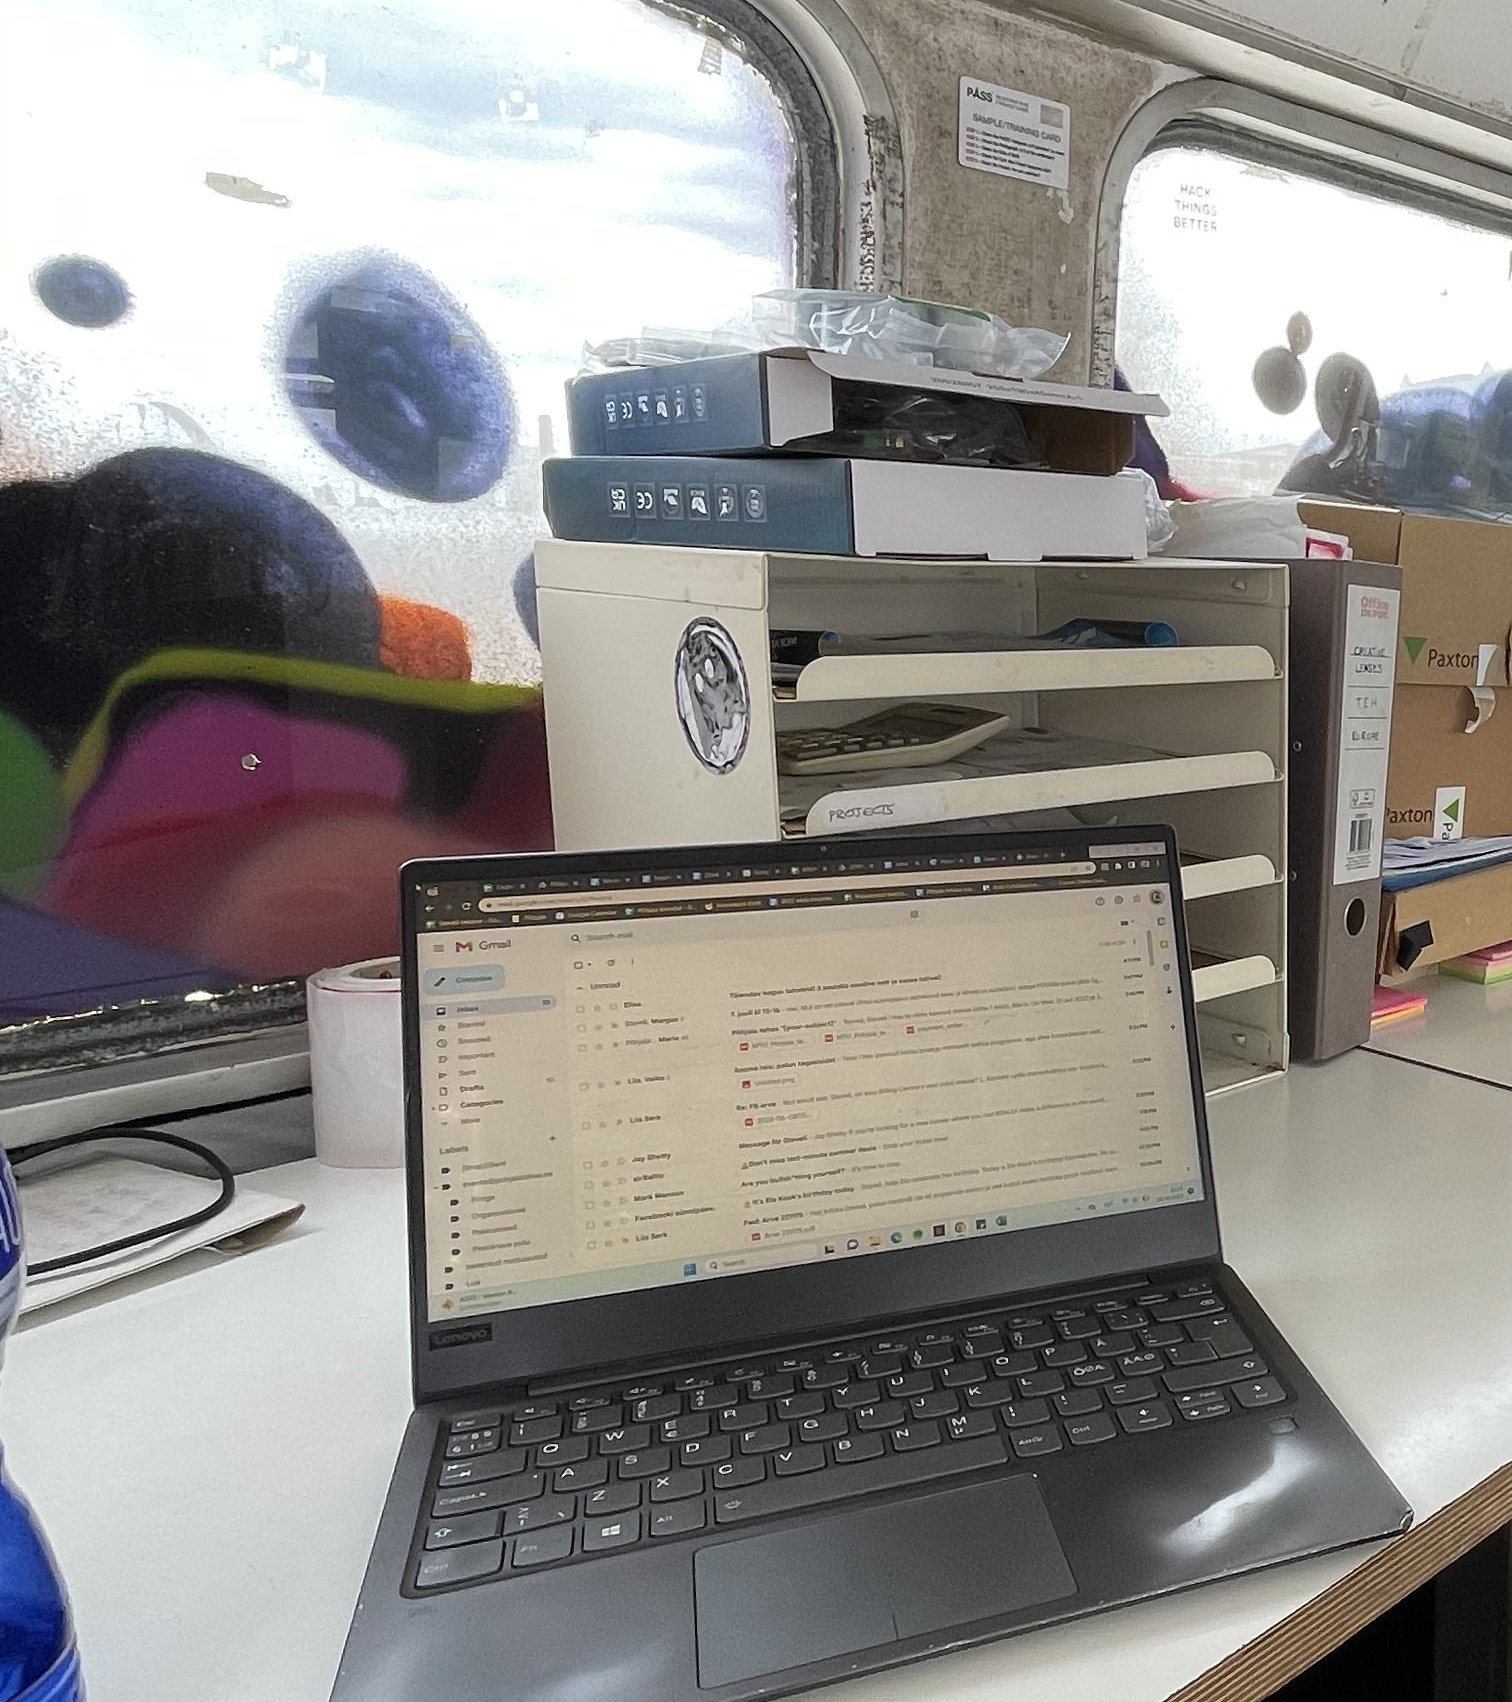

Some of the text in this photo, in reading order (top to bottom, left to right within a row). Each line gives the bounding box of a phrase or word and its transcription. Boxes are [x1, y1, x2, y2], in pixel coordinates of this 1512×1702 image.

[1180, 184, 1211, 198] HACK
[1174, 199, 1217, 217] THINGS
[1173, 216, 1217, 232] BETTER
[1428, 648, 1479, 669] Paxton
[829, 804, 895, 821] PROJECTS
[479, 940, 511, 950] Gmail
[434, 1328, 488, 1345] Lenovo
[891, 1376, 904, 1386] U
[837, 1387, 848, 1396] Y
[968, 1386, 982, 1396] K
[915, 1398, 925, 1407] J
[860, 1407, 874, 1417] H
[951, 1416, 967, 1427] M
[605, 1430, 624, 1441] W
[745, 1431, 756, 1441] F
[896, 1428, 909, 1438] N
[686, 1442, 700, 1453] D
[838, 1440, 851, 1450] B
[624, 1455, 638, 1465] S
[779, 1452, 792, 1462] V
[561, 1467, 575, 1478] A
[718, 1464, 733, 1475] C
[656, 1477, 669, 1488] X
[592, 1490, 606, 1501] Z
